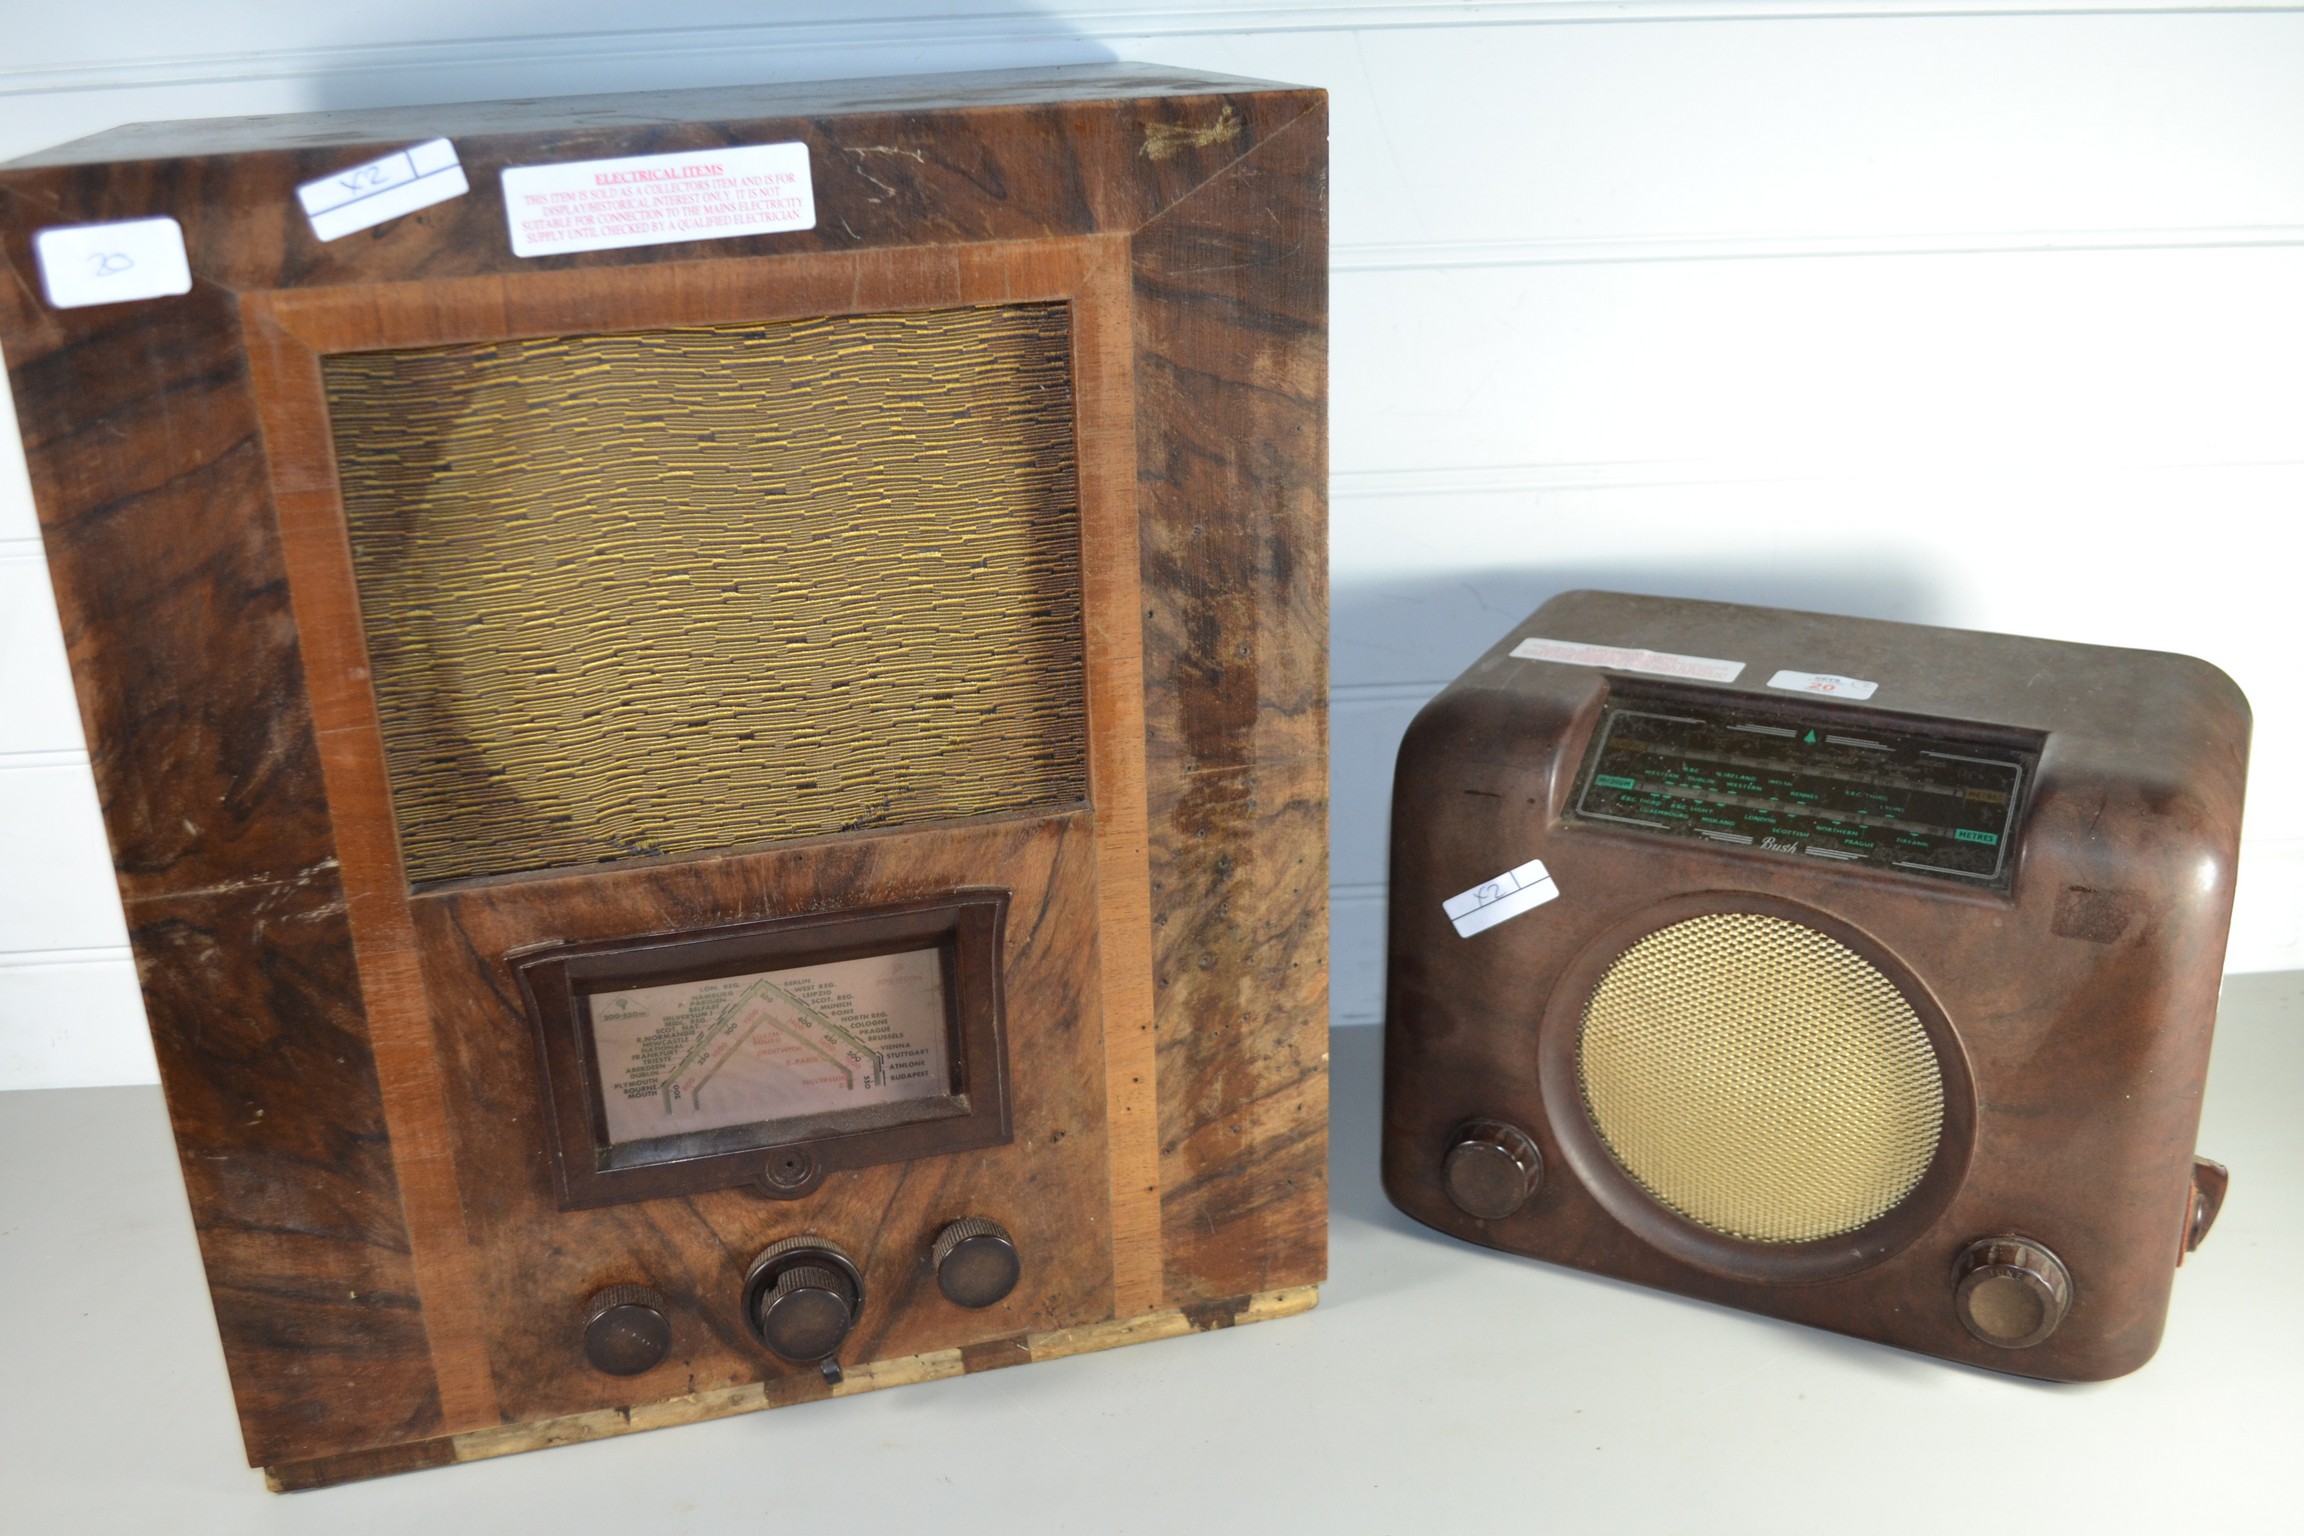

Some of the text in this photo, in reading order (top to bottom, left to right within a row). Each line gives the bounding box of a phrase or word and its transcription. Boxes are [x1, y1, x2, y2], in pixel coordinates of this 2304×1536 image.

[595, 164, 724, 186] ELECTRICAL ITEMS
[524, 195, 547, 205] THIS
[551, 192, 576, 202] ITEM
[579, 191, 588, 200] IS
[591, 188, 617, 199] SOLD
[622, 187, 633, 196] AS
[644, 181, 709, 194] COLLECTORS
[713, 178, 737, 188] ITEM
[741, 176, 761, 186] AND
[764, 174, 773, 183] IS
[776, 173, 795, 182] FOR
[654, 194, 700, 206] INTEREST
[736, 189, 745, 199] IT
[749, 189, 757, 197] IS
[760, 187, 780, 196] NOT
[522, 197, 803, 231] SUITABLE FOR CONNECTION TO THE MAINS ELECTRICITY
[526, 230, 564, 244] SUPPLY
[568, 227, 597, 239] UNTIL
[601, 222, 649, 236] CHECKED
[651, 221, 665, 232] BY
[677, 215, 731, 231] QUALIFIED
[1809, 683, 1836, 691] 20
[1701, 817, 1735, 826] MIDLAND
[1744, 814, 1777, 824] LONDON
[1771, 827, 1810, 838] SCOTTISH
[1815, 825, 1859, 837] NORTHERN
[1958, 831, 1994, 842] METRES
[1760, 837, 1799, 854] Bush
[1844, 839, 1874, 848] PRAGUE
[784, 978, 811, 987] BERLIN
[794, 984, 815, 992] WEST
[802, 990, 832, 999] LEIPZIG
[689, 1004, 719, 1013] BELFAST
[820, 1001, 852, 1010] MUNICH
[663, 1012, 708, 1022] HILVERSUM
[831, 1008, 854, 1016] ROME
[797, 1017, 812, 1029] 400
[841, 1014, 869, 1023] NORTH
[850, 1019, 889, 1029] COLOGNE
[723, 1022, 738, 1036] 300
[859, 1026, 890, 1035] PRAGUE
[642, 1036, 689, 1048] NEWCASTLE
[823, 1034, 838, 1045] 450
[868, 1032, 904, 1042] BRUSSELS
[641, 1043, 683, 1054] NATIONAL
[880, 1043, 911, 1051] VIENNA
[631, 1050, 679, 1061] FRANKFURT
[697, 1053, 710, 1066] 250
[847, 1051, 862, 1063] 500
[886, 1049, 929, 1060] STUTTGART
[643, 1056, 672, 1066] TRIESTE
[889, 1060, 925, 1071] ATHLONE
[625, 1063, 666, 1074] ABERDEEN
[630, 1071, 659, 1080] DUBLIN
[890, 1071, 929, 1081] BUDAPEST
[613, 1078, 659, 1090] PLYMOUTH
[627, 1091, 658, 1100] MOUTH
[673, 1084, 681, 1100] 200
